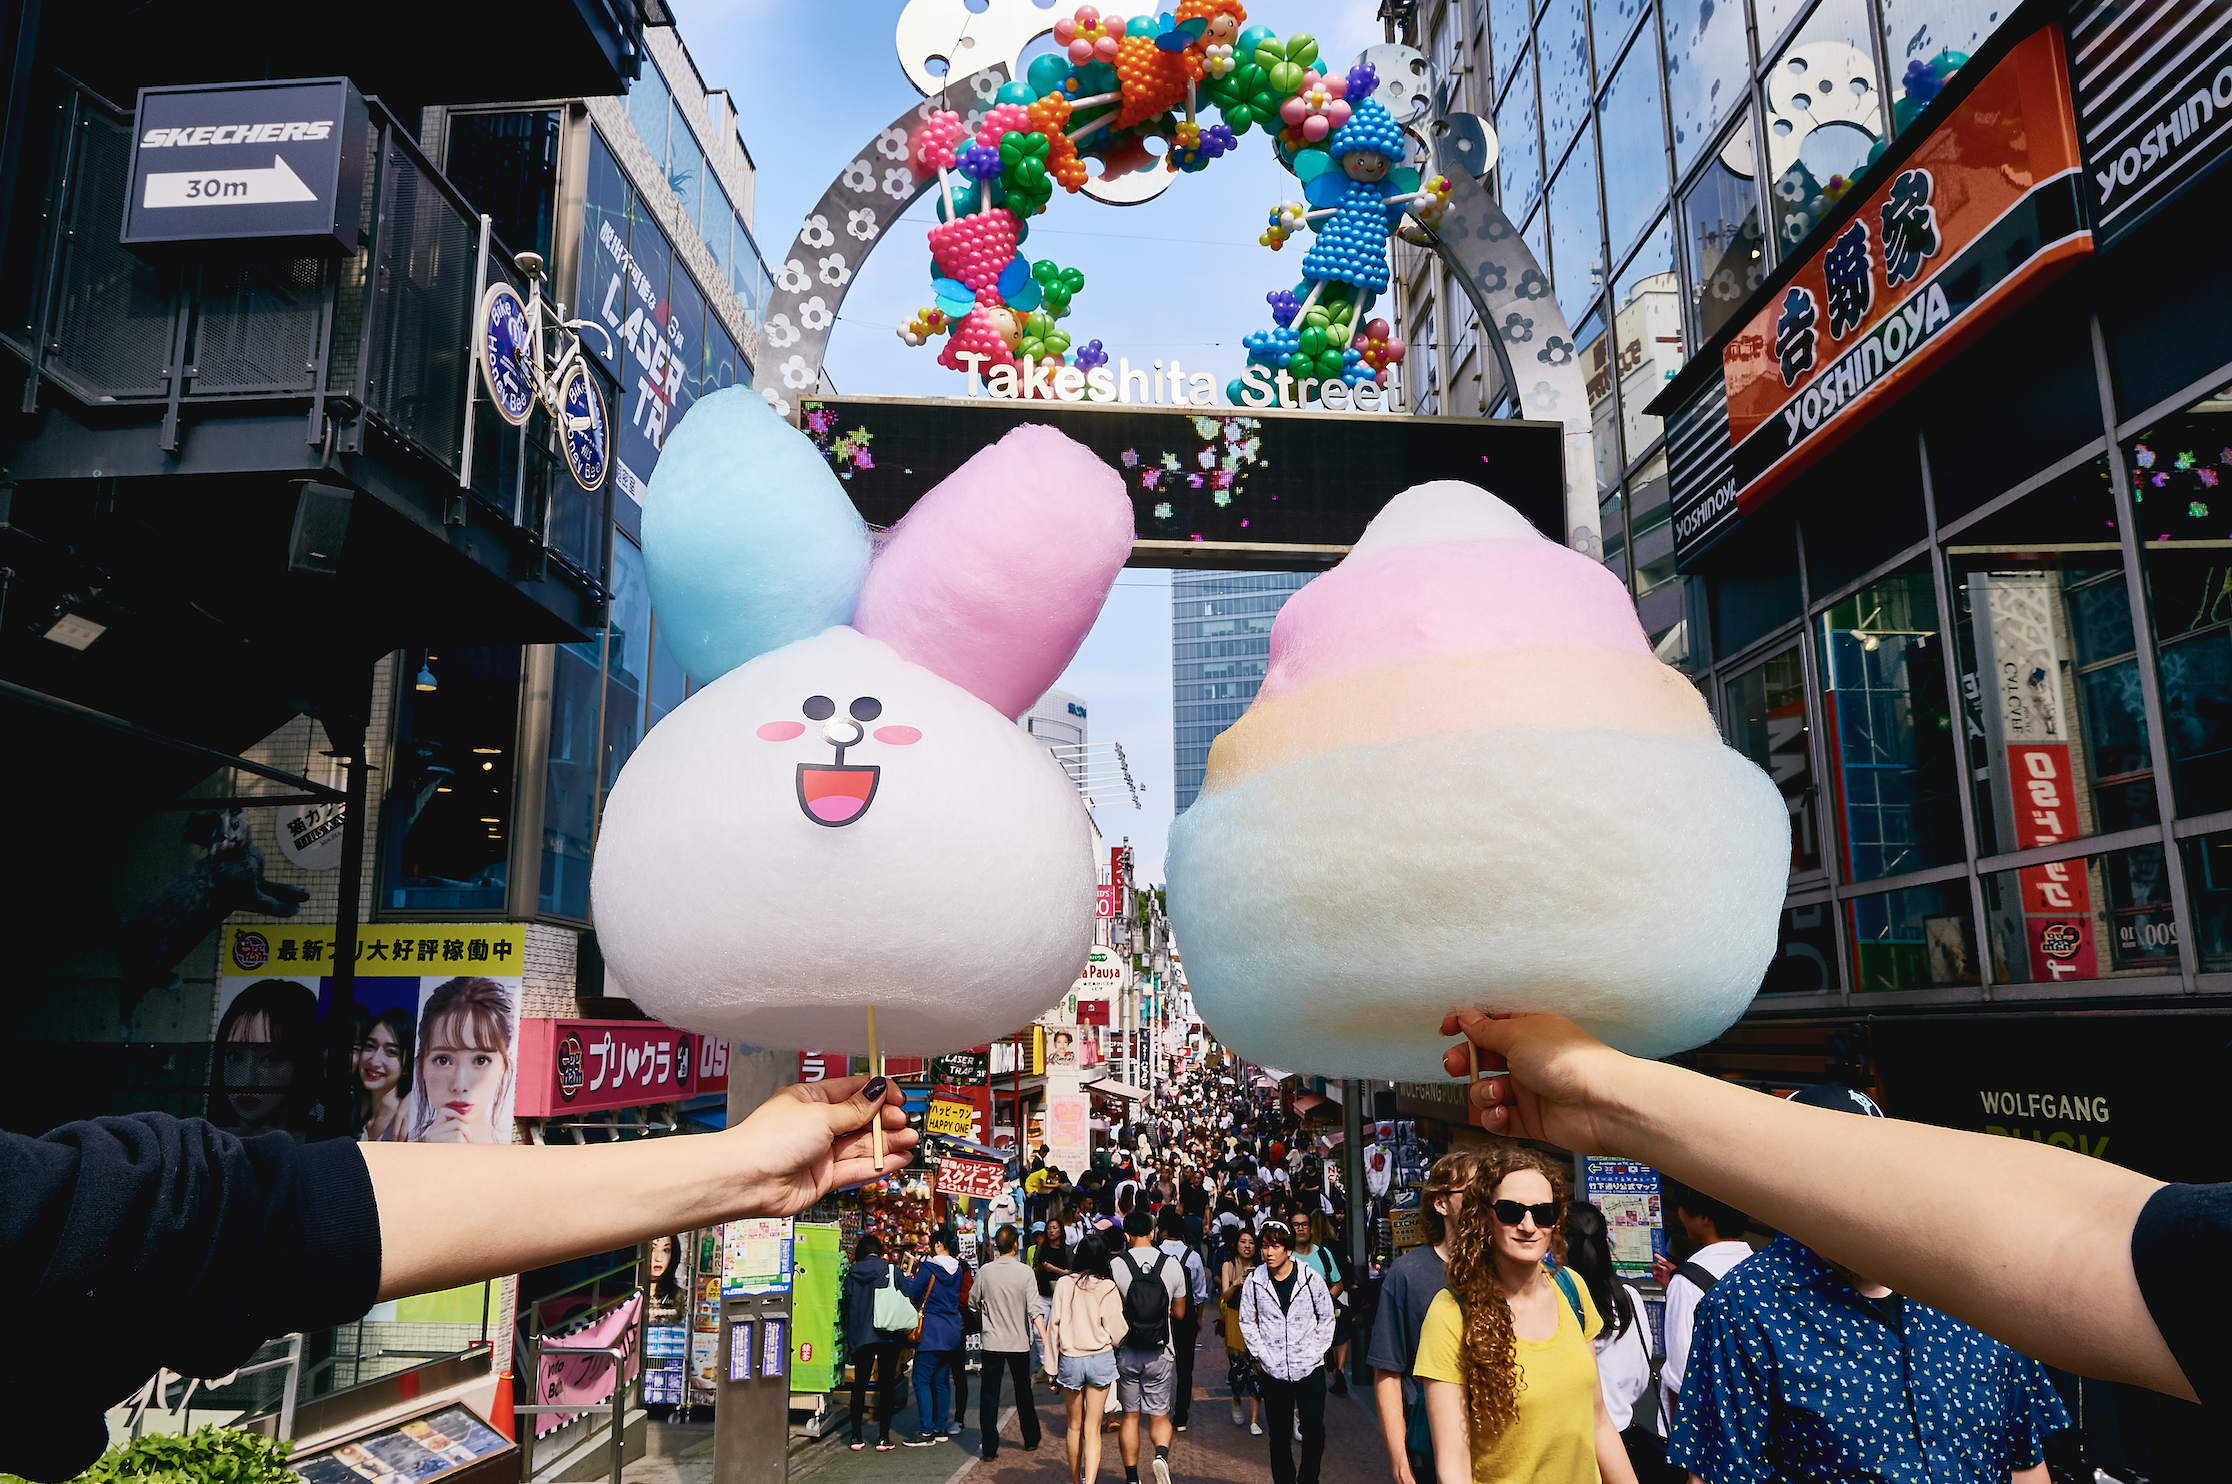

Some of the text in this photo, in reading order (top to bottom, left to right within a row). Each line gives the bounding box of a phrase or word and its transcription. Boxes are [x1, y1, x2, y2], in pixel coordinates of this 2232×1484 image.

[140, 120, 334, 149] SKECHERS
[185, 178, 248, 199] 30m
[1775, 167, 1942, 388] 吉野家
[491, 298, 512, 327] Bike
[601, 272, 685, 406] LASER
[488, 334, 508, 405] Honey
[510, 392, 527, 412] Bee
[1784, 281, 1950, 446] YOSHINOYA
[568, 381, 588, 405] Bike
[954, 350, 1406, 414] Takeshita Street
[633, 375, 679, 452] TR
[1676, 477, 1737, 543] YOSHINOYA
[1096, 898, 1109, 915] 0
[1090, 965, 1120, 980] Pausa
[700, 1036, 730, 1078] OS
[945, 1054, 974, 1065] LASER
[950, 1066, 987, 1078] TRAP 3F
[931, 1105, 971, 1120] ハッピーワン
[1980, 1090, 2110, 1123] WOLFGANG
[929, 1118, 970, 1134] HAPPY ONE
[938, 1168, 1003, 1190] スクイーズ
